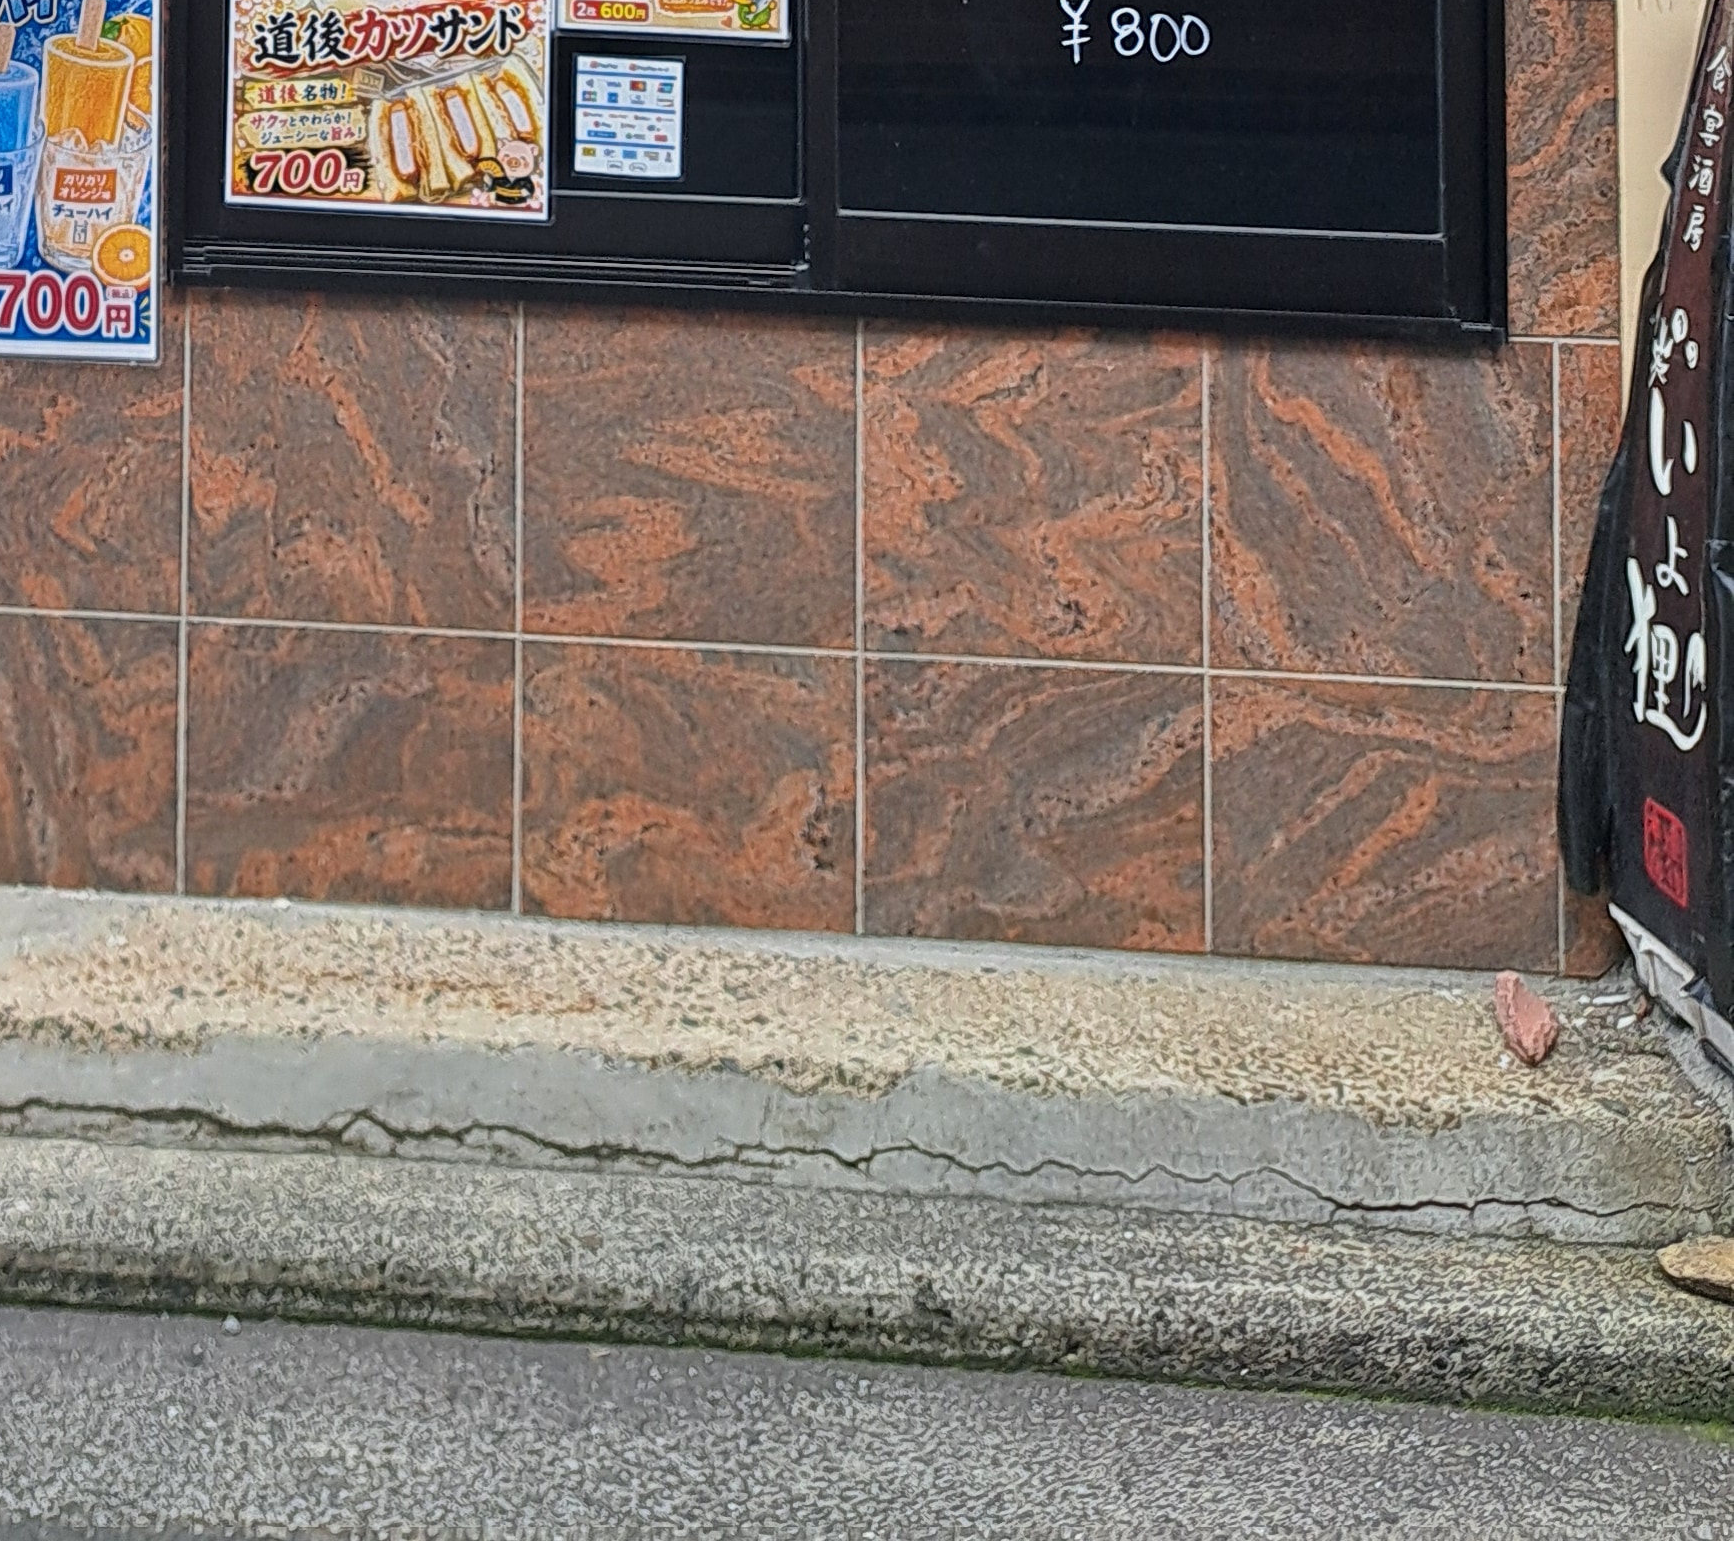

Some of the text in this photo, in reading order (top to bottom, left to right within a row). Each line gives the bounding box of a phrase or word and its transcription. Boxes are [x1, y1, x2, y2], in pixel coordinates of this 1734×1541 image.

[600, 3, 646, 19] 600円
[254, 6, 521, 65] 道後カツサンド
[257, 82, 347, 103] 道後名物!
[253, 151, 363, 192] 700円
[53, 204, 114, 220] チューハイ
